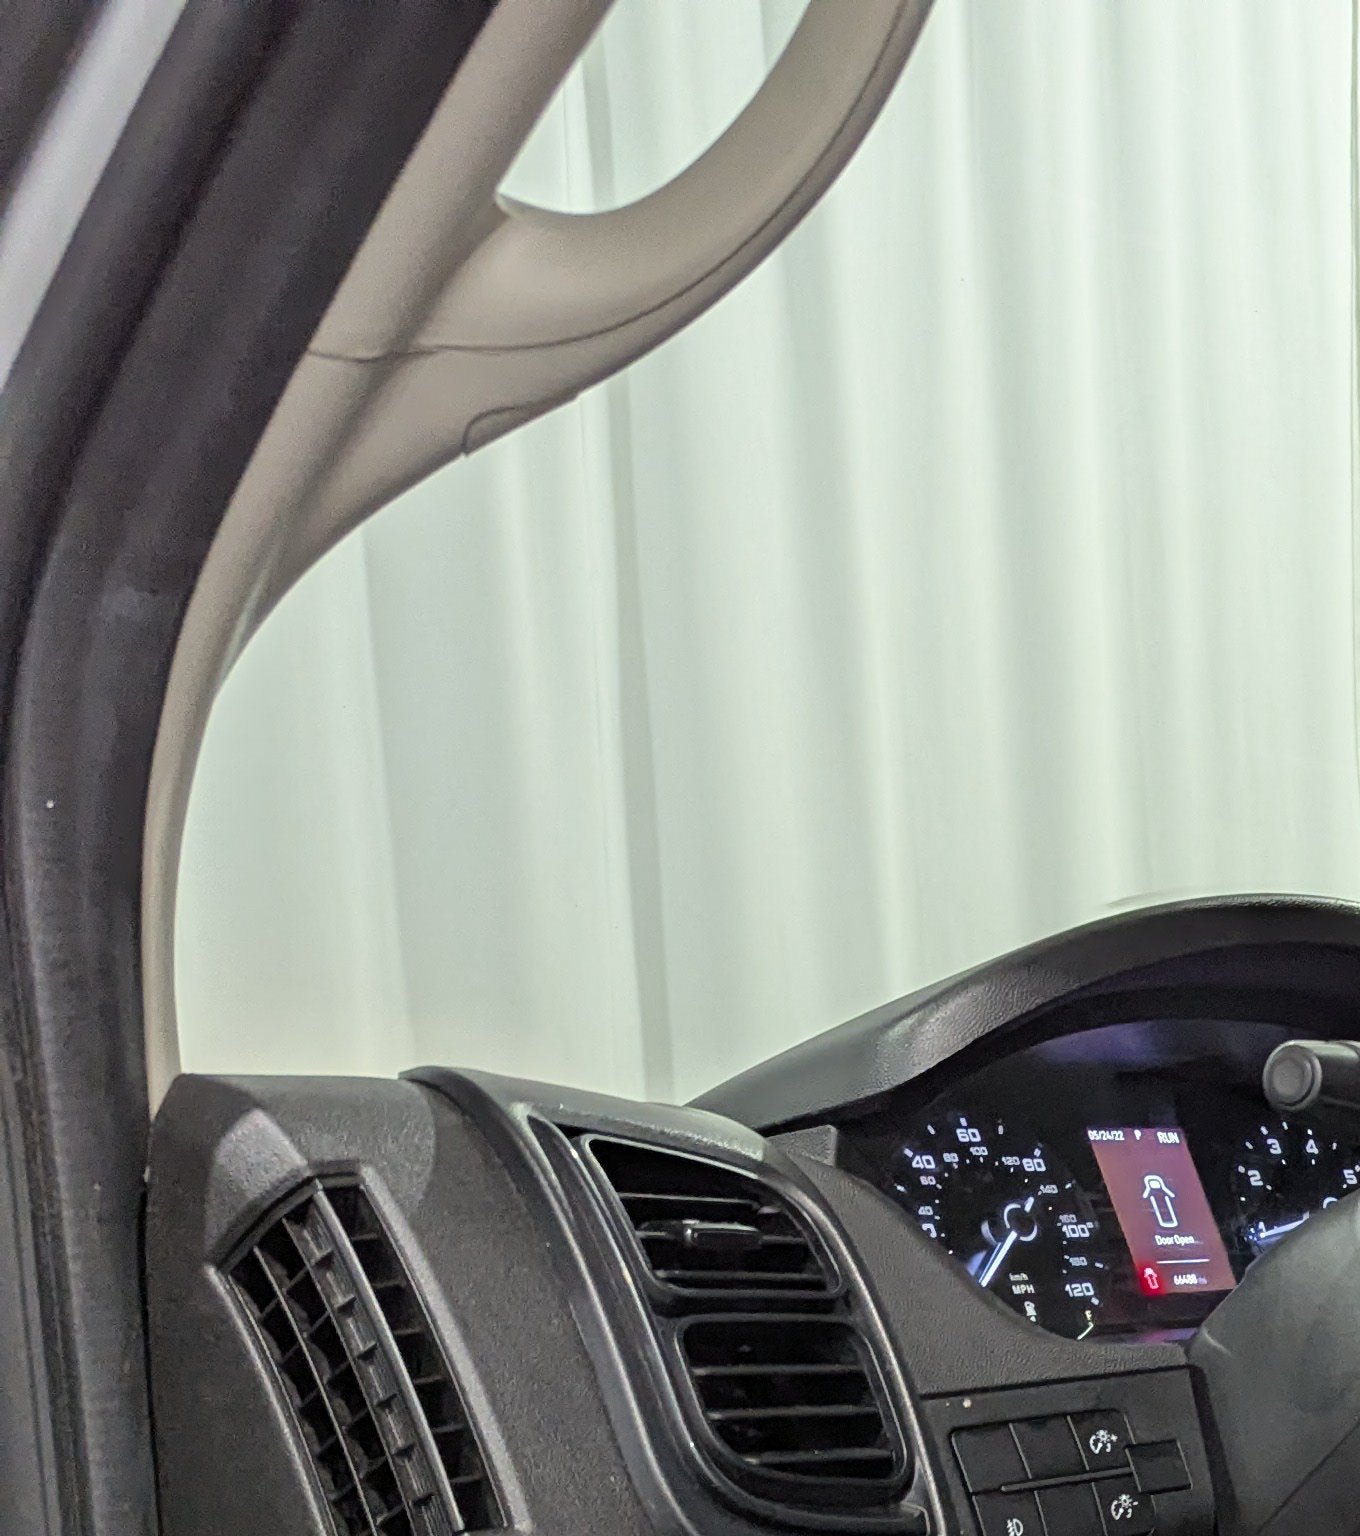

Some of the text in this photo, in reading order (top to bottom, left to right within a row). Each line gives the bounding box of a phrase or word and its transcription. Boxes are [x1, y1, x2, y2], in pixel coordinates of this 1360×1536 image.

[955, 1127, 981, 1142] 60
[1156, 1131, 1180, 1144] RUN
[1266, 1138, 1282, 1154] 3
[1305, 1139, 1319, 1154] 4
[911, 1154, 936, 1170] 40
[1022, 1157, 1047, 1172] 80
[1247, 1169, 1264, 1187] 2
[1343, 1169, 1358, 1185] 5
[1061, 1224, 1090, 1239] 100
[1155, 1235, 1174, 1246] Door
[1011, 1284, 1035, 1295] MPH
[1064, 1282, 1095, 1297] 120
